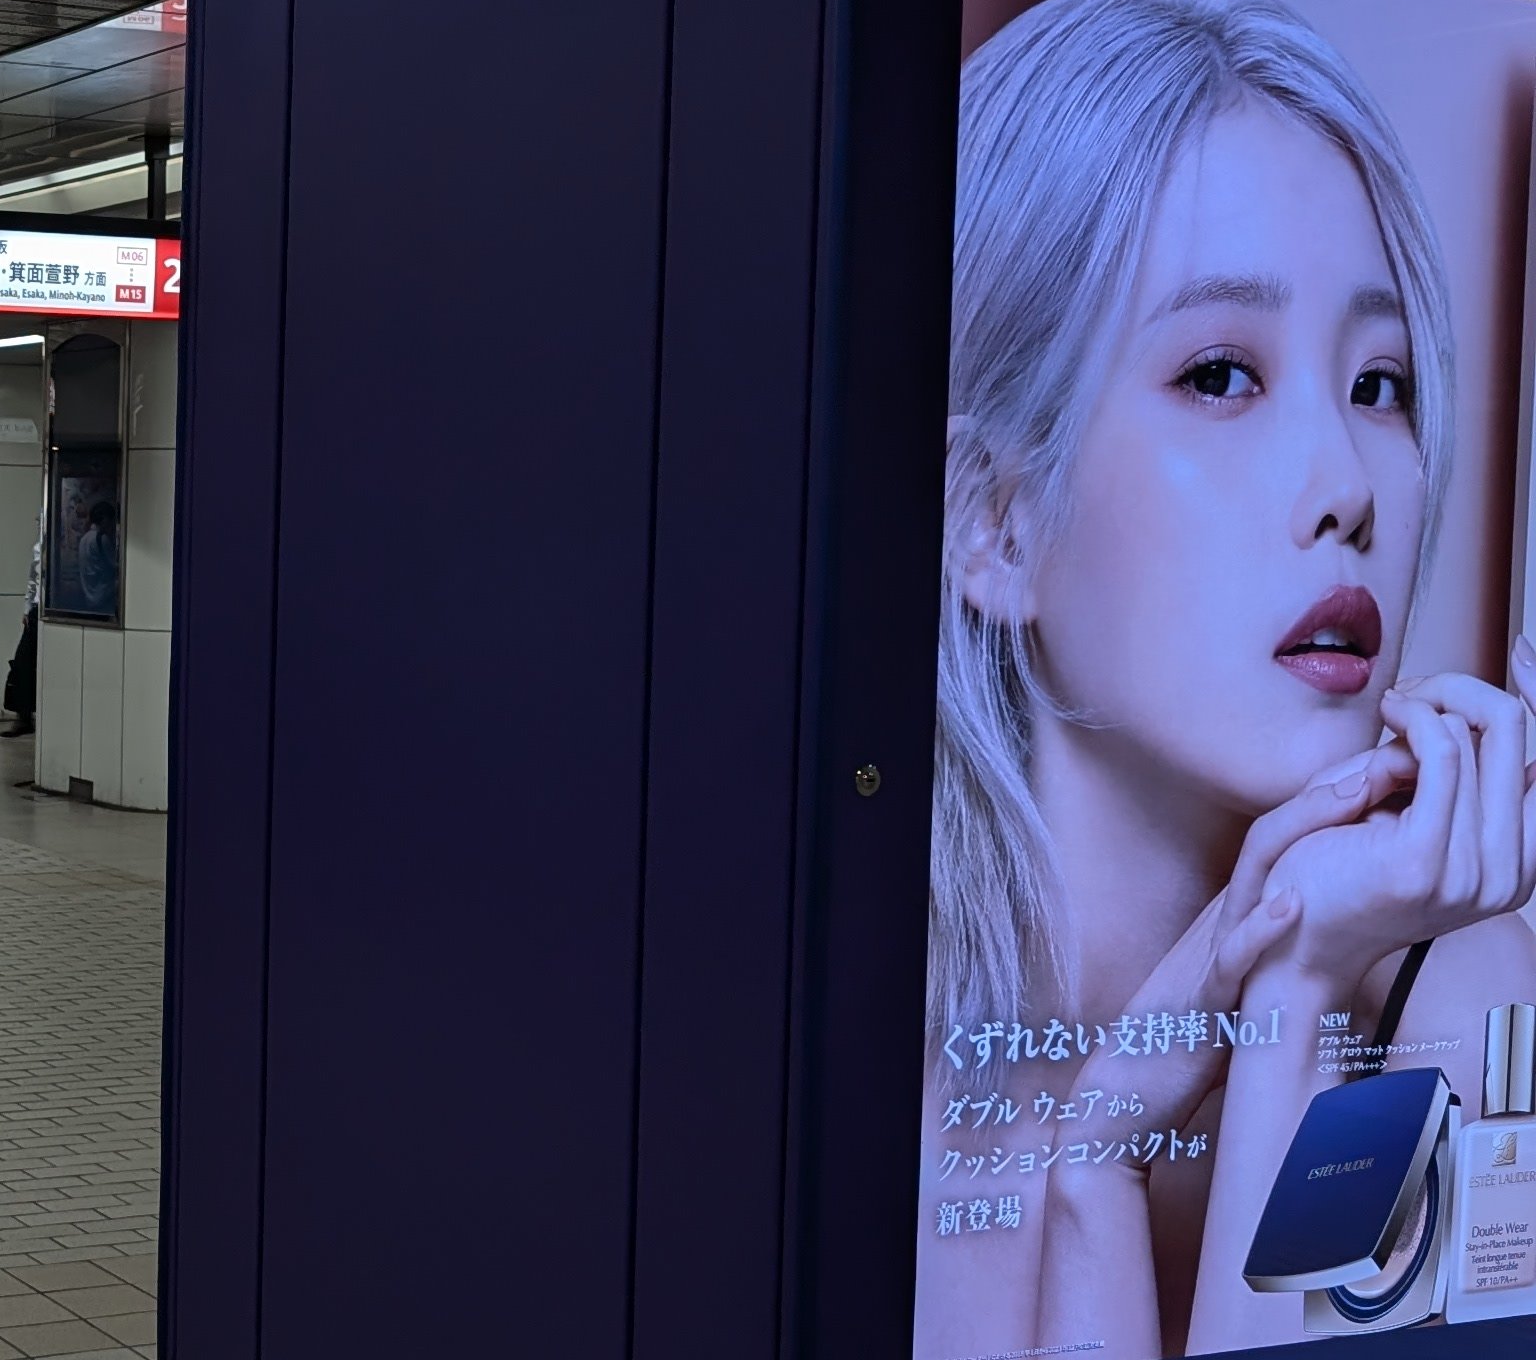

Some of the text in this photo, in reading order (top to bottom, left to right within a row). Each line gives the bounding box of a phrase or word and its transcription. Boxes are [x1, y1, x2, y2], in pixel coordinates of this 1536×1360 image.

[121, 251, 144, 262] M06
[84, 271, 107, 287] 方面
[163, 258, 181, 294] 2
[22, 288, 48, 300] Esaka,
[49, 291, 106, 304] Minoh-Kayano
[120, 288, 143, 300] M15
[1319, 1012, 1351, 1028] NEW
[1318, 1034, 1364, 1047] ダブル ウェア
[939, 1089, 1145, 1133] ダブル ウェアから
[940, 1129, 1208, 1181] クッションコンパクトが
[1336, 1157, 1375, 1174] LAUDER
[935, 1195, 1023, 1236] 新登場
[1472, 1222, 1529, 1238] Double Wear
[1465, 1237, 1534, 1253] Stay-in-Place Makeup
